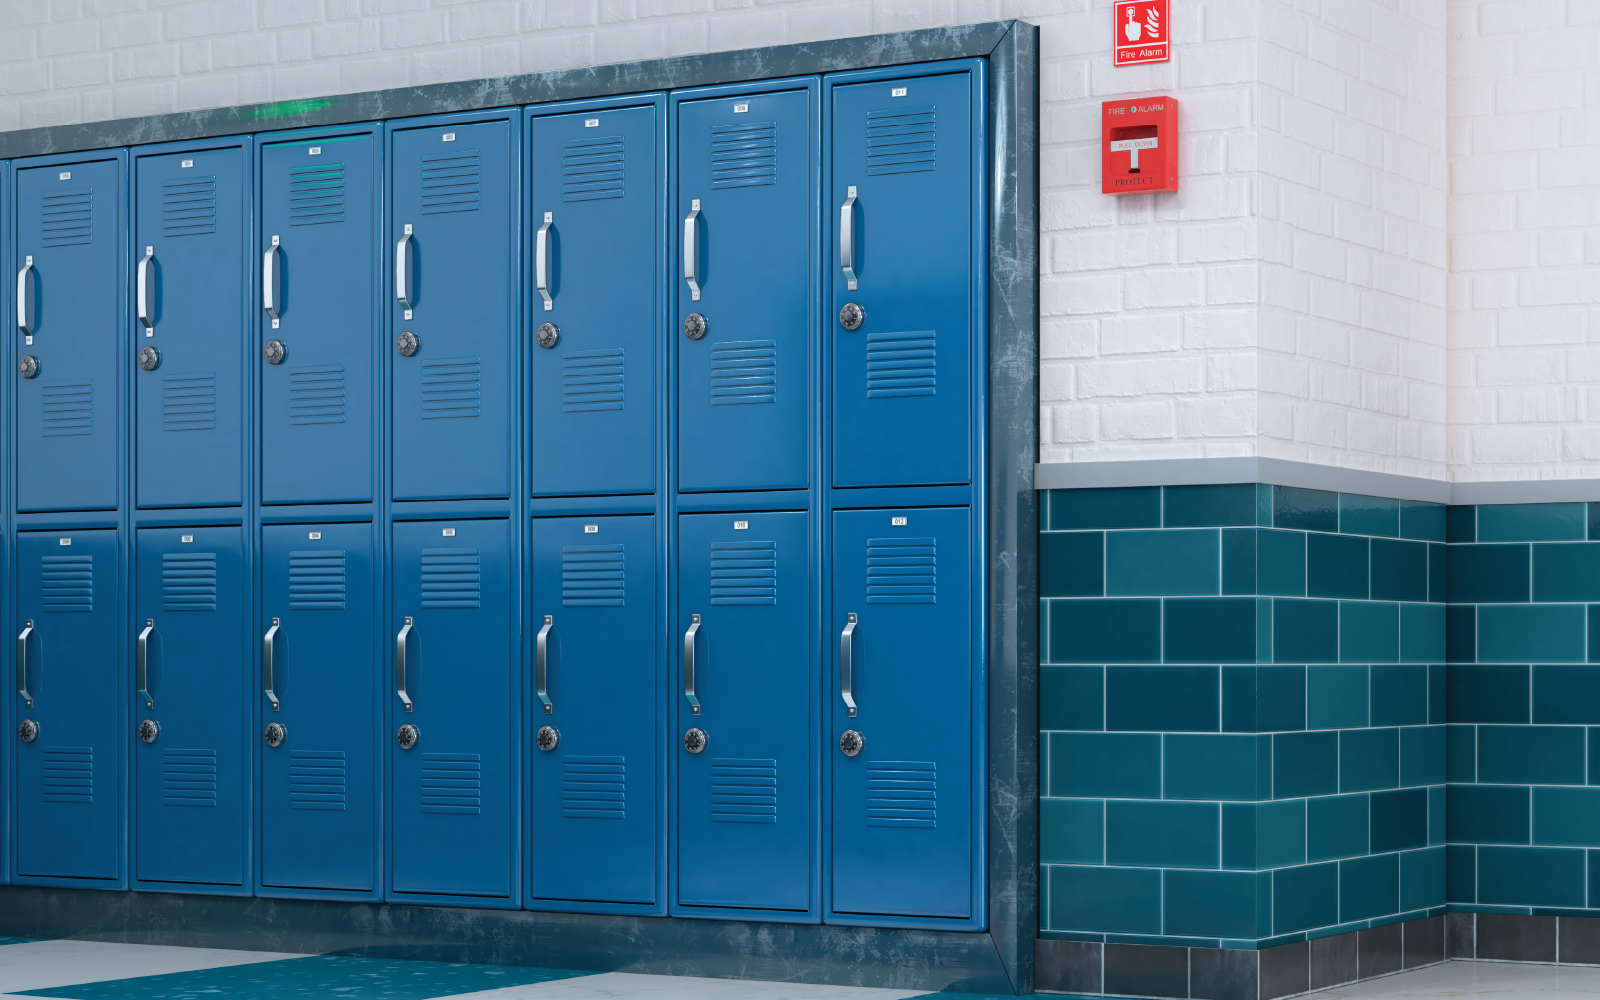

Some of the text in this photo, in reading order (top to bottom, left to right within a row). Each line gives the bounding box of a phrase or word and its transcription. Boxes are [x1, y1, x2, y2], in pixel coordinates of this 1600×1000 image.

[1120, 48, 1163, 60] Fire Alarm
[1108, 104, 1164, 116] FIRE ALARM
[1118, 140, 1153, 149] PULL DOWN
[1115, 176, 1154, 187] PROTECT
